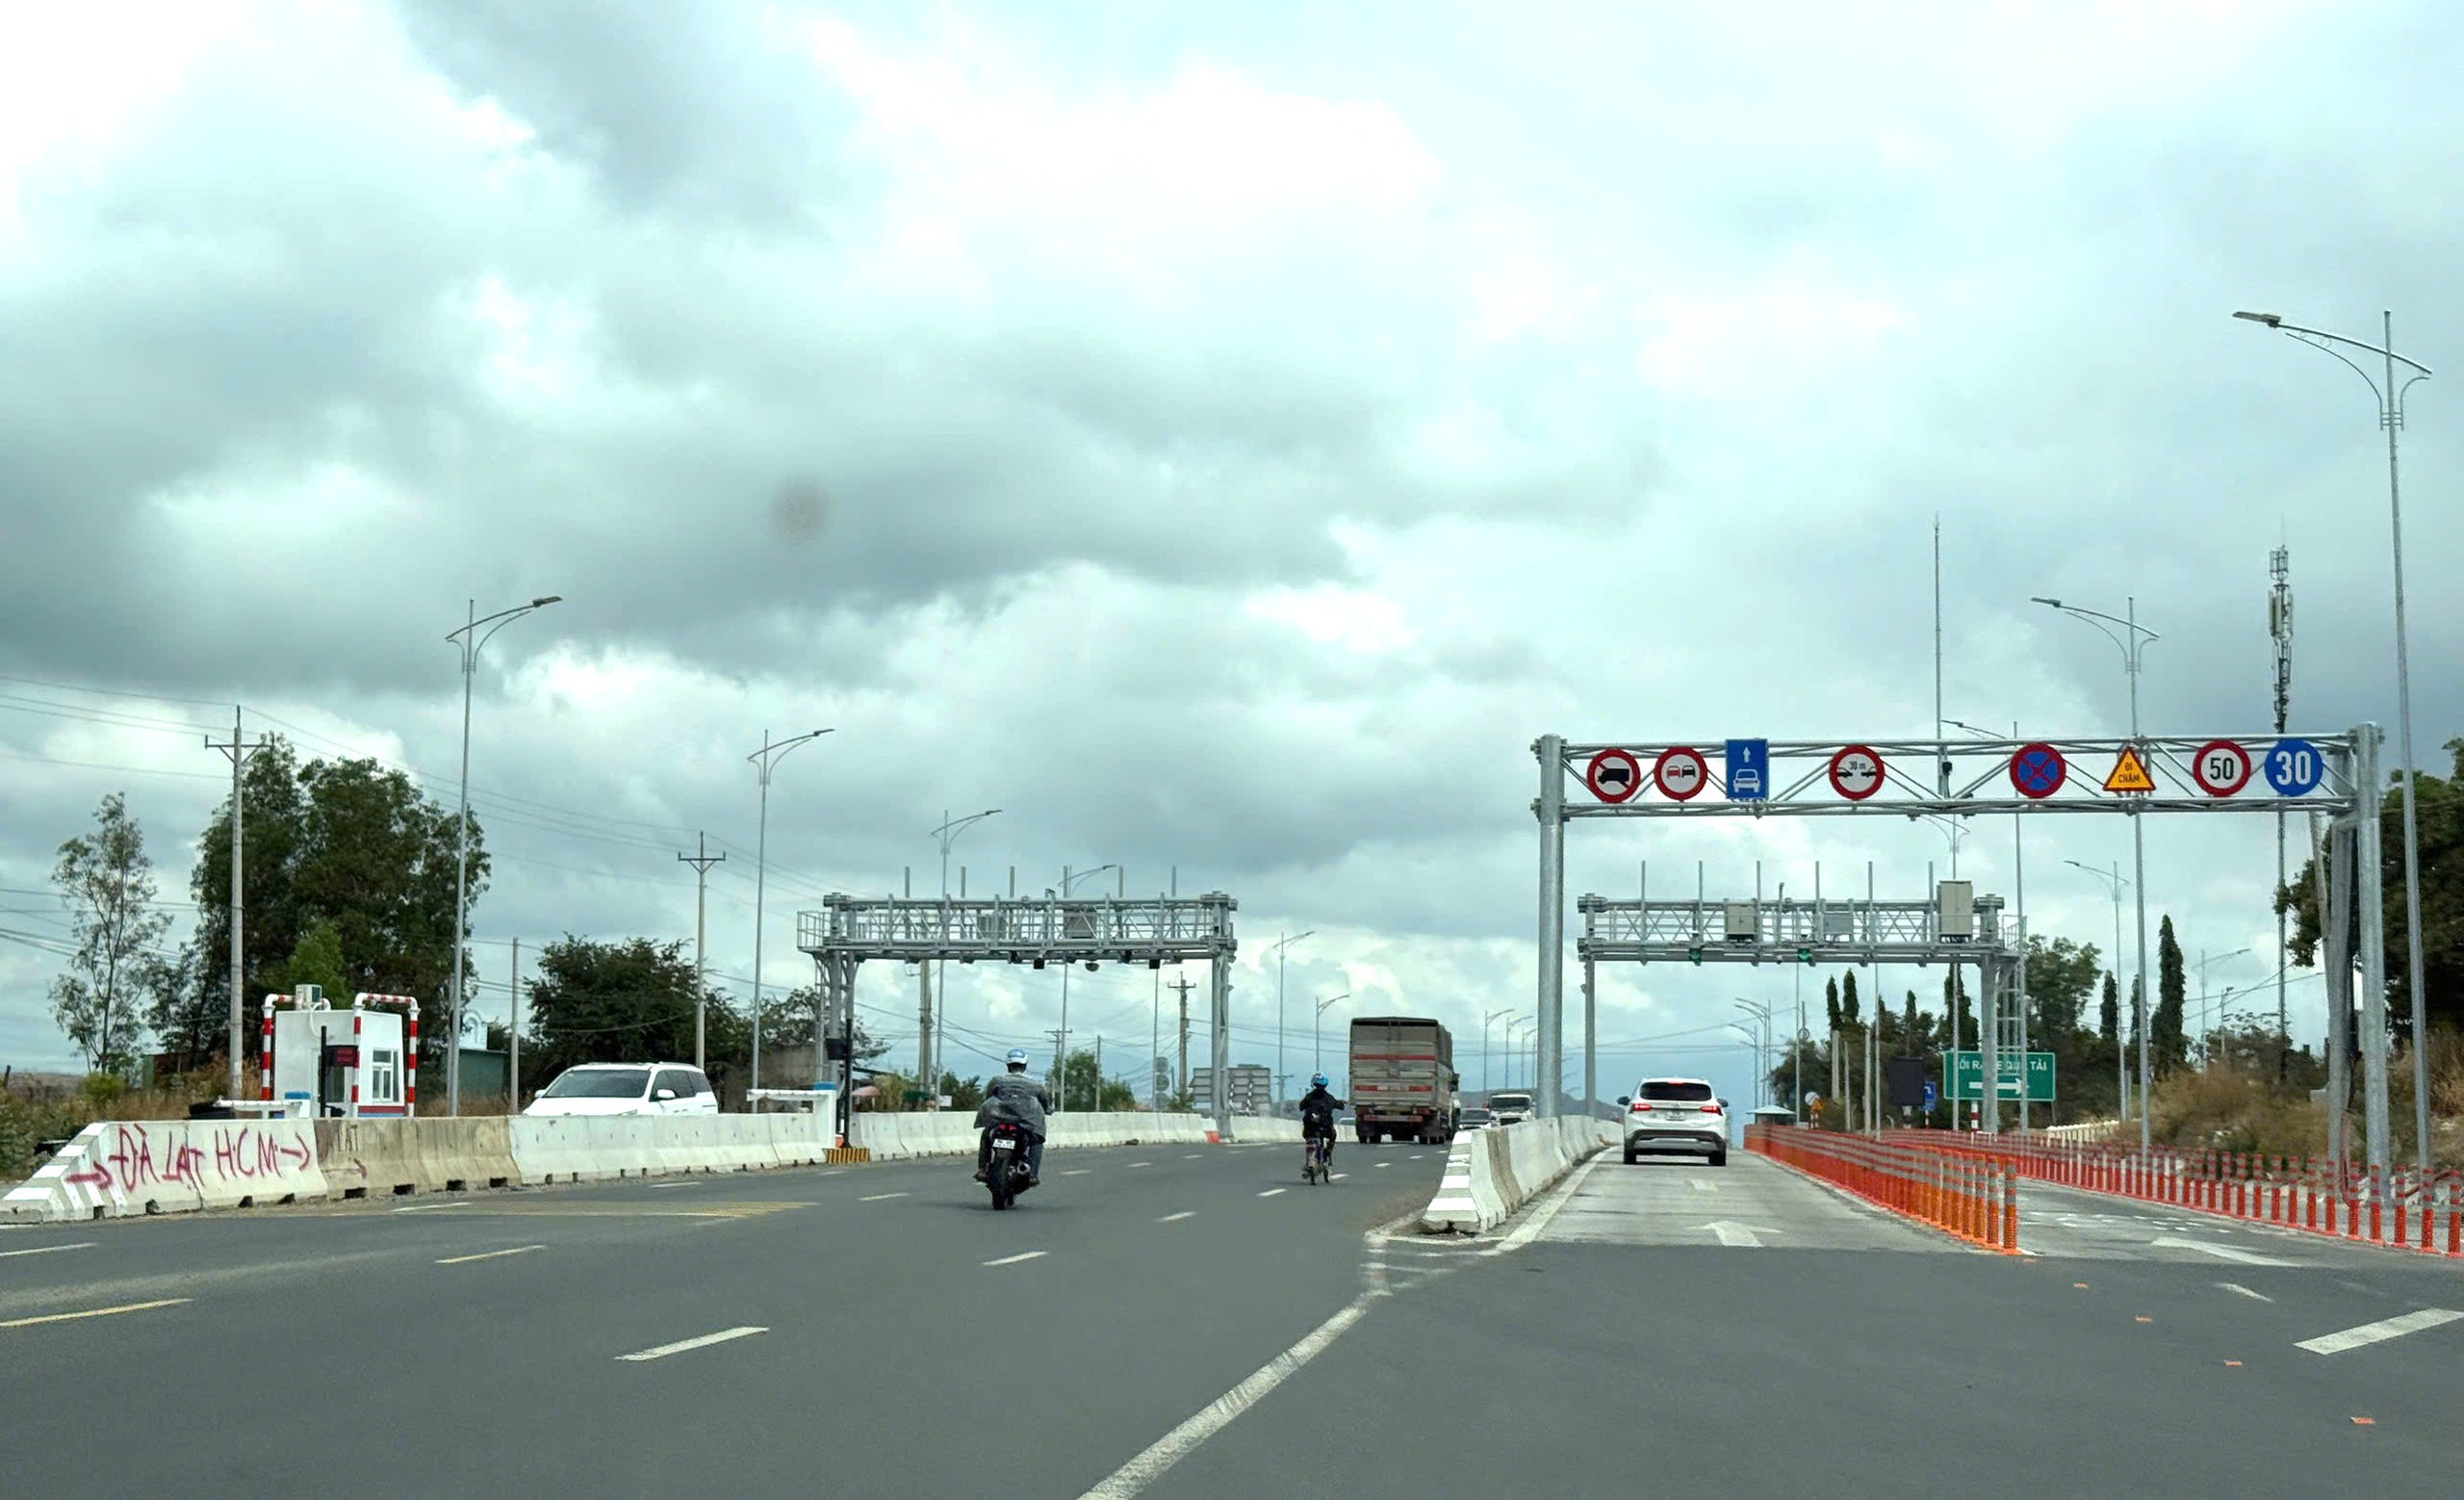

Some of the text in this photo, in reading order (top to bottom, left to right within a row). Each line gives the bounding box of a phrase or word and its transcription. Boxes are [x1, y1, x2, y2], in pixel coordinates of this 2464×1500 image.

[2210, 758, 2234, 780] 50
[2276, 751, 2311, 785] 30
[1956, 1056, 1969, 1070] ỐI
